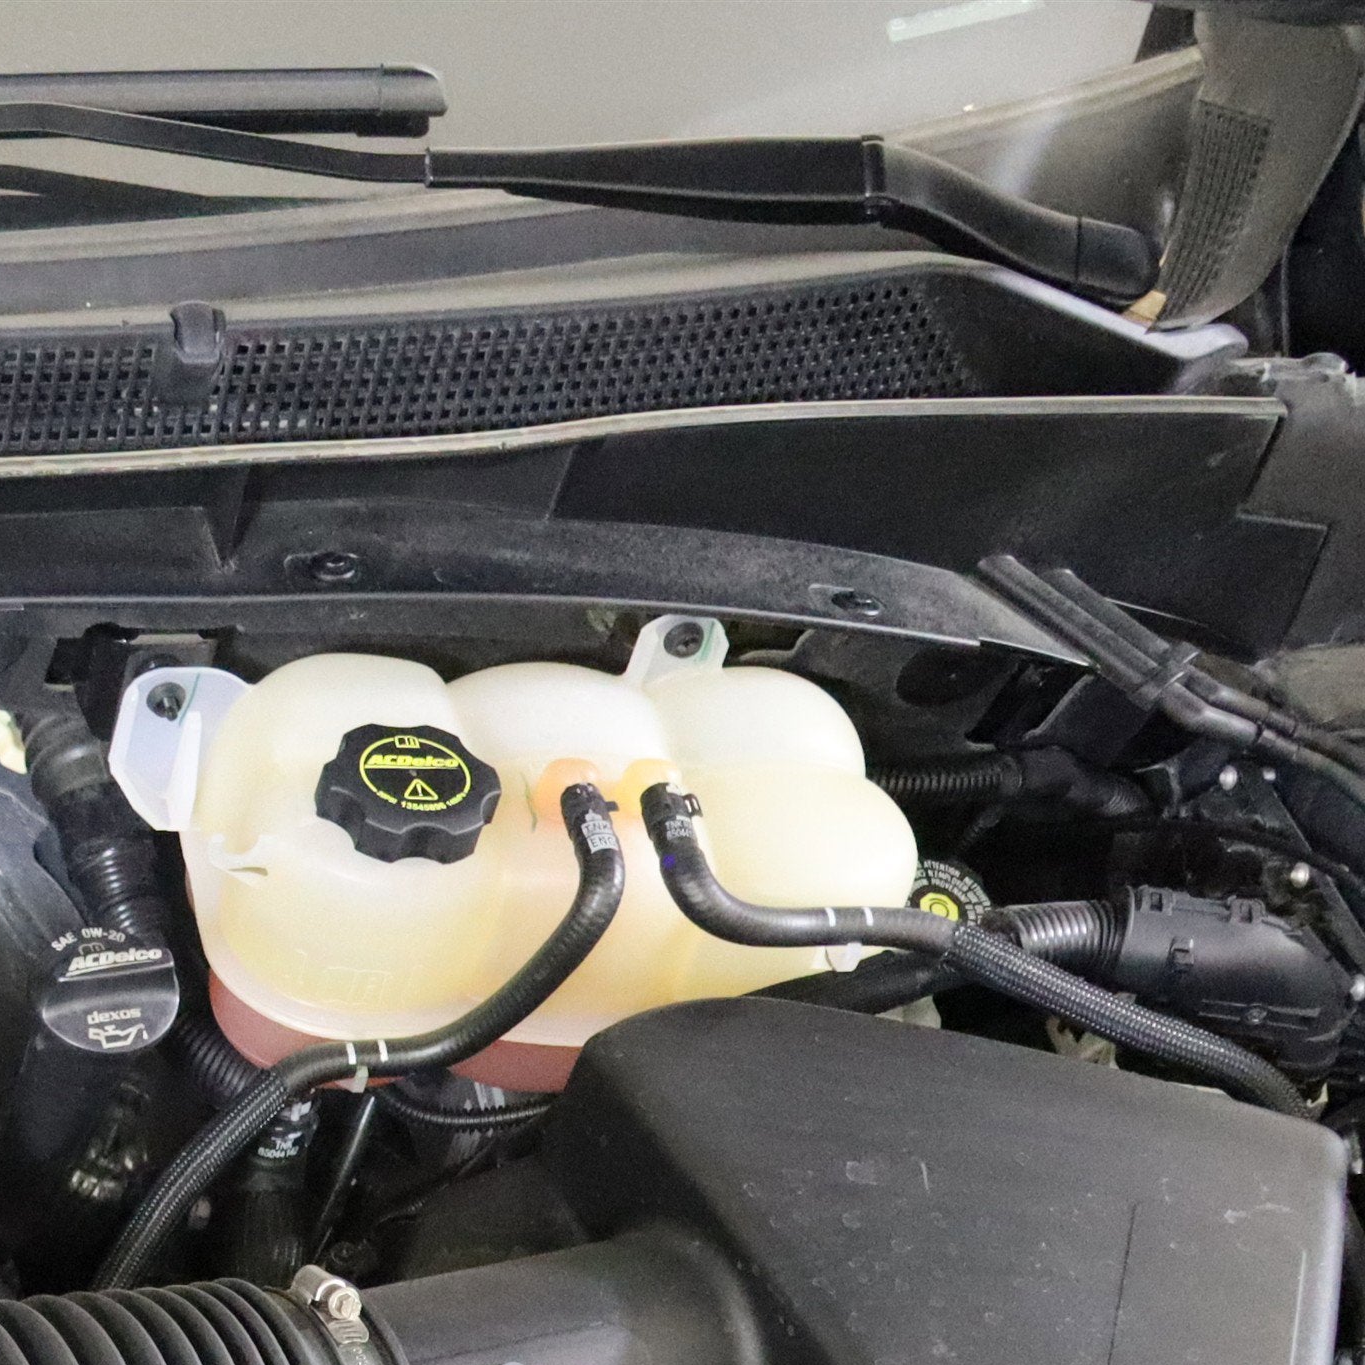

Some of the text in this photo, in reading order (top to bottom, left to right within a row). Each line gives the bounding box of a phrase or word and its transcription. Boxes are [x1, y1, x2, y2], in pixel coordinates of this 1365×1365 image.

[366, 754, 459, 768] ACDelco
[51, 927, 126, 952] SAE 0W-20
[68, 948, 162, 971] ACDelco
[87, 1007, 142, 1024] dexos
